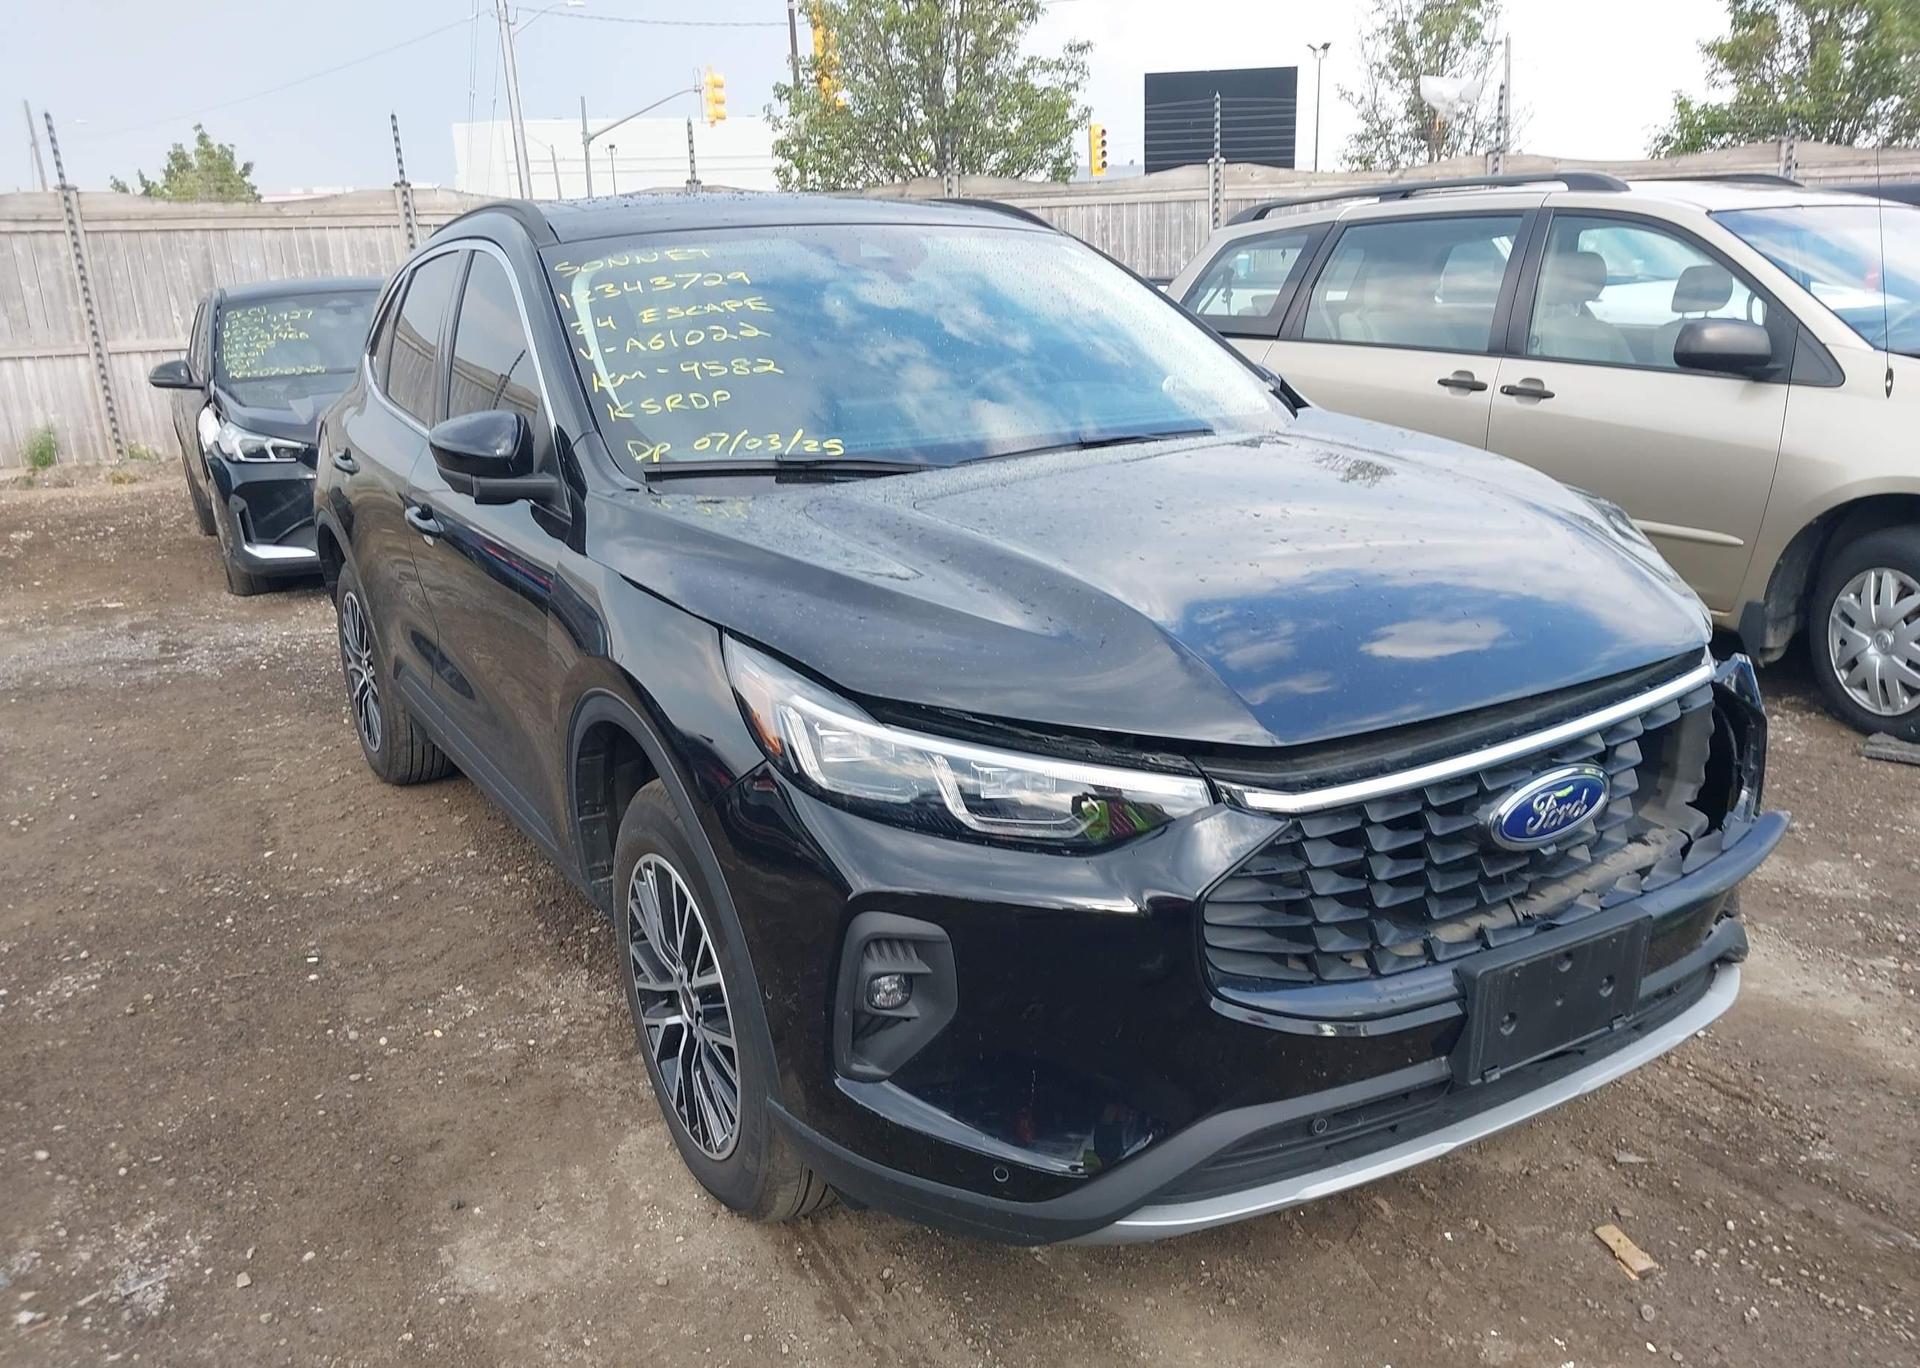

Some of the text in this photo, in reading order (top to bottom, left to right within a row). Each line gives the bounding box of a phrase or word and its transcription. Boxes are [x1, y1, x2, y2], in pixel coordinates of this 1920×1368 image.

[554, 248, 711, 278] SONNET
[559, 271, 752, 310] 12343729
[638, 296, 776, 325] ESCAPE
[693, 427, 846, 457] 07/03/25
[1526, 784, 1590, 836] Ford
